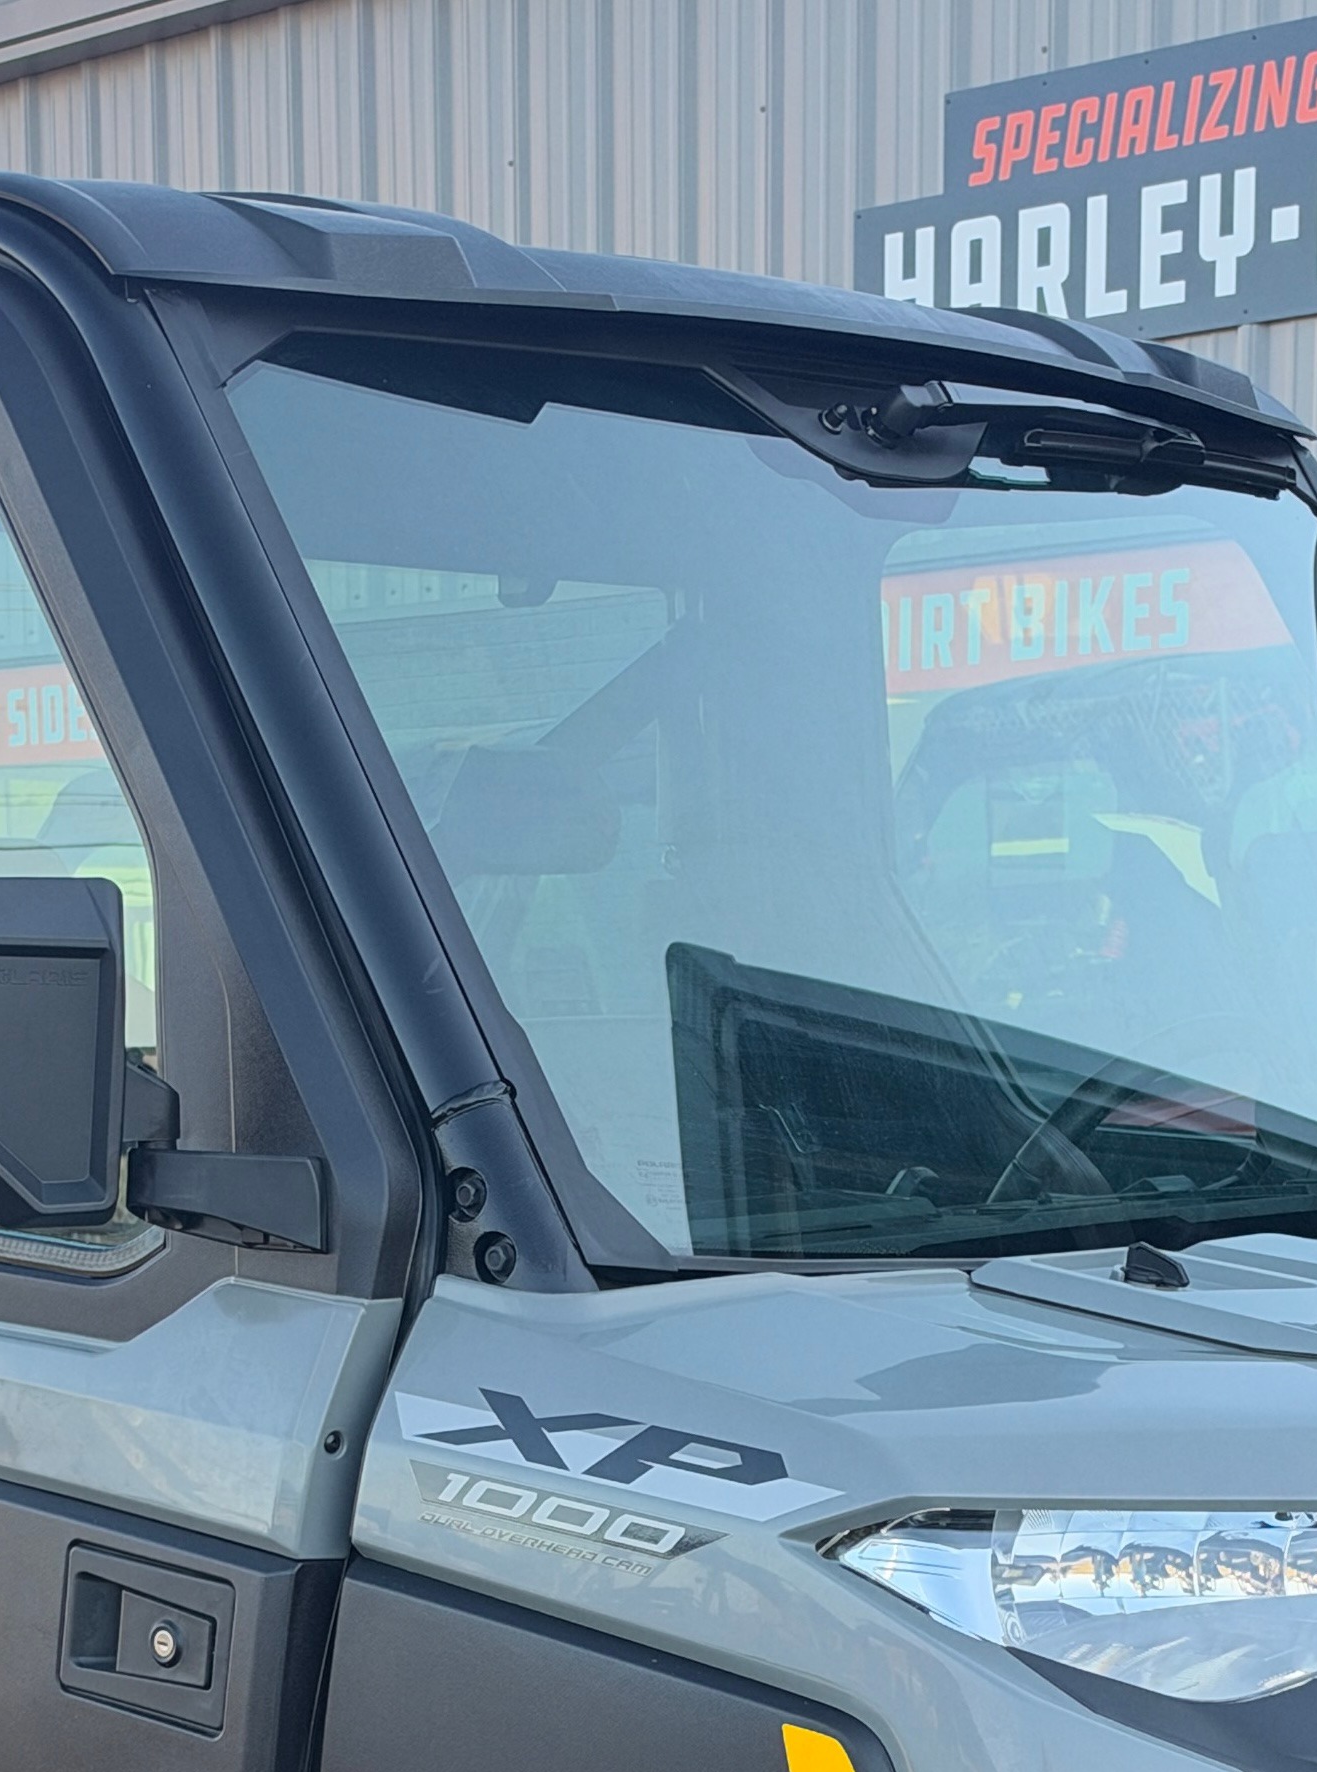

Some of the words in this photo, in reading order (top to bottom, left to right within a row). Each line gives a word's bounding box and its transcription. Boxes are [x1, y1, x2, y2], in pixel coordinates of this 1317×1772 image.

[881, 588, 991, 673] IRT
[1010, 567, 1190, 662] BIKES
[7, 684, 97, 748] SIDE
[412, 1387, 789, 1485] XP
[418, 1511, 475, 1534] DUAL
[481, 1527, 598, 1563] OVERHEAD
[600, 1555, 654, 1577] CAM
[437, 1473, 686, 1554] 1000
